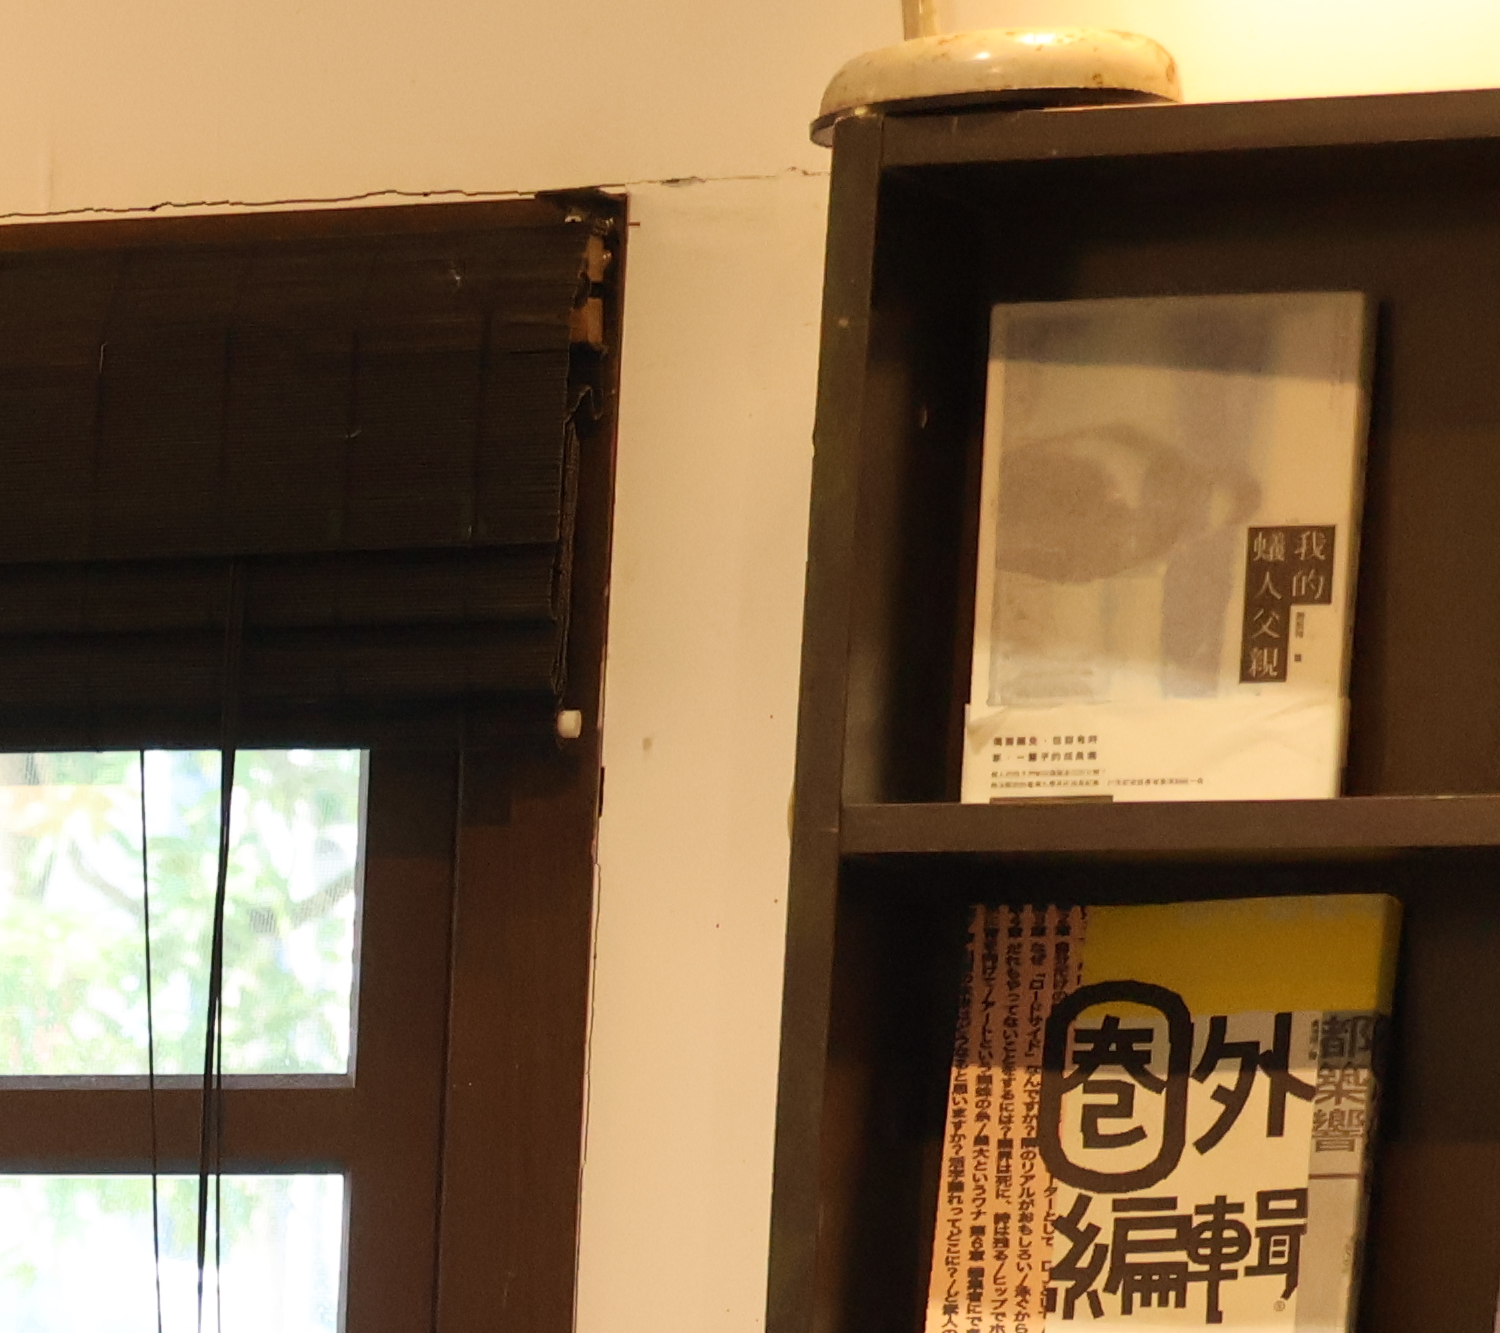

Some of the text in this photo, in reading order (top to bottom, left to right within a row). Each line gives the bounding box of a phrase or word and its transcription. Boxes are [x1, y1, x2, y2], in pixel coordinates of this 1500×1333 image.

[1249, 530, 1287, 679] 蟻人父親
[1290, 529, 1327, 601] 我的
[1038, 980, 1318, 1195] 圈外
[1044, 1188, 1309, 1325] 編輯
